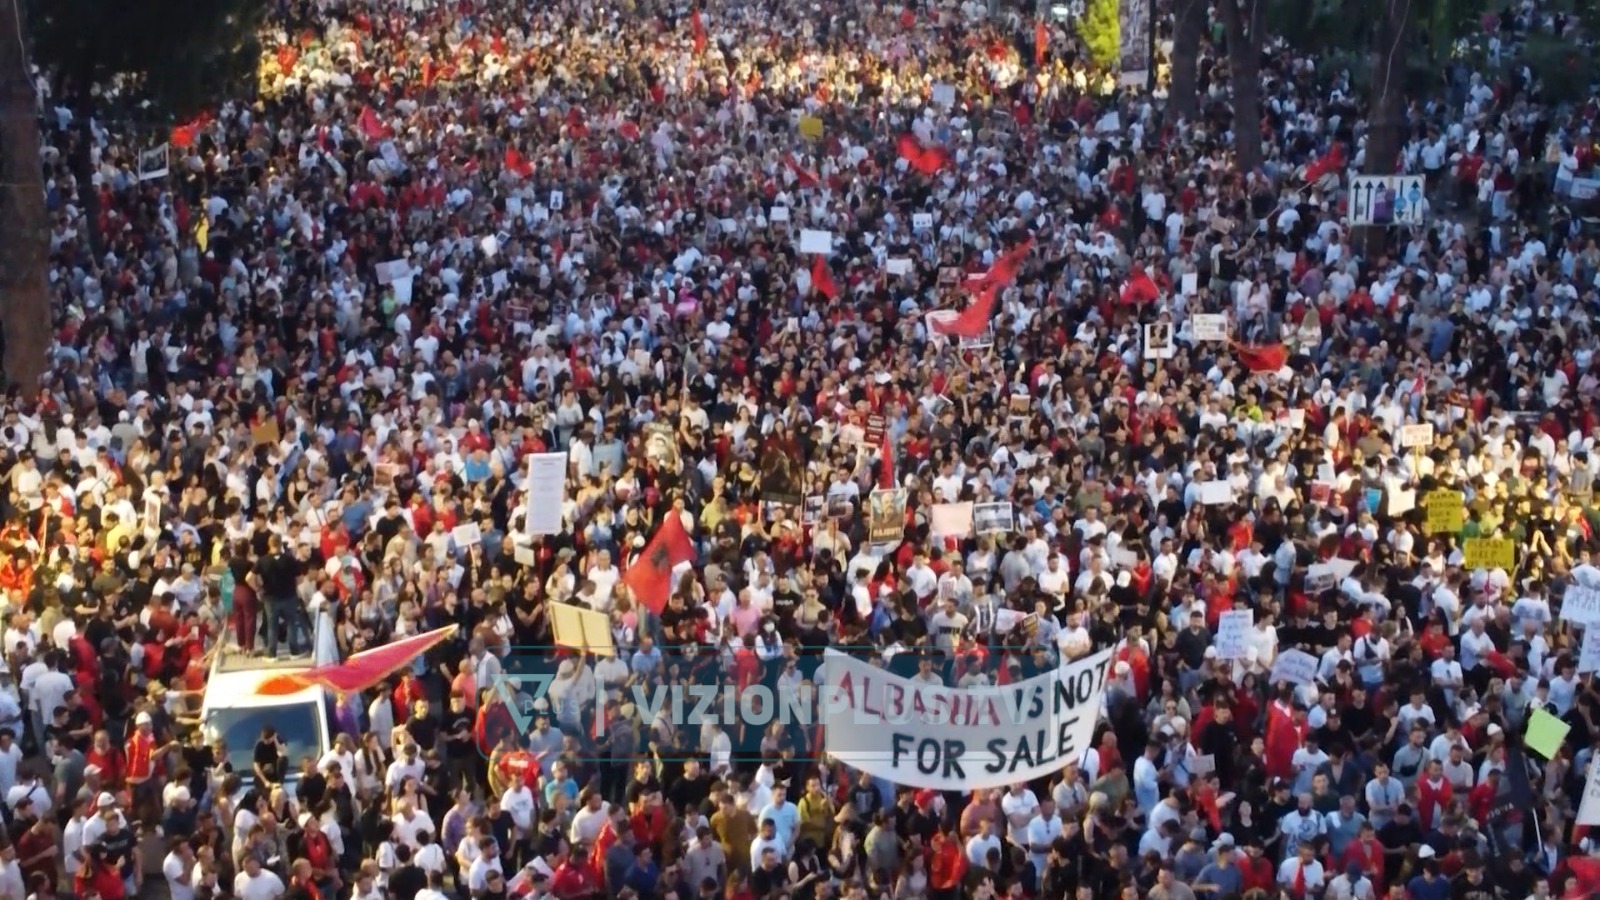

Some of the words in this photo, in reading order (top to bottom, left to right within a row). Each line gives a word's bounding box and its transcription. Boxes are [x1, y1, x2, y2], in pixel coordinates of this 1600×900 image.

[834, 671, 1000, 726] ALBANIA
[1015, 685, 1044, 719] IS
[1054, 659, 1110, 714] NOT
[892, 733, 966, 779] FOR
[985, 717, 1080, 773] SALE
